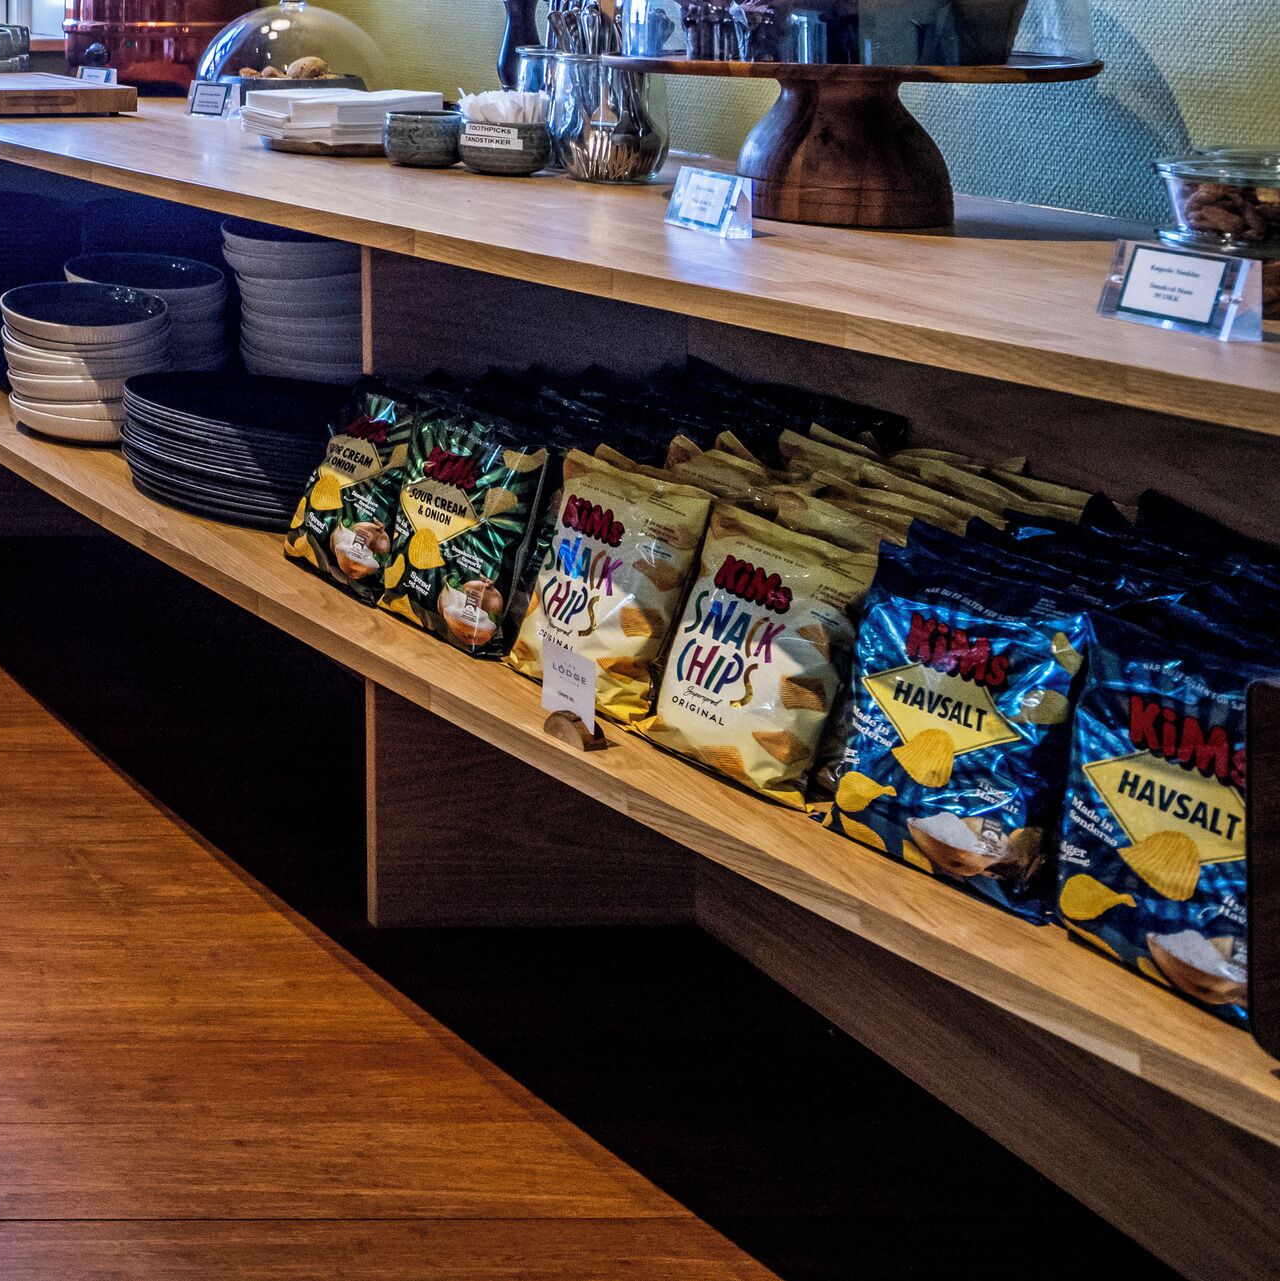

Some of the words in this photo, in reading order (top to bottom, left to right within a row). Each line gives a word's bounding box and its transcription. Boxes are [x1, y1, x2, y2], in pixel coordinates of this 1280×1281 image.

[465, 135, 511, 146] TANDSTIKKER
[468, 124, 512, 135] TOOTHPICKS
[331, 456, 357, 474] ONION
[342, 448, 374, 468] CREAM
[409, 487, 432, 505] SOUR
[434, 496, 467, 518] CREAM
[417, 505, 424, 515] &
[424, 509, 452, 526] ONION
[544, 530, 623, 596] SNACK
[714, 554, 793, 614] KiMs
[542, 575, 600, 637] CHIPS
[684, 590, 786, 663] SNACK
[677, 638, 759, 708] CHIPS
[906, 612, 1010, 687] KiMs
[671, 695, 725, 727] ORIGINAL
[892, 679, 987, 732] HAVSALT
[1129, 695, 1246, 786] KiMs
[1071, 795, 1101, 823] Made
[1100, 819, 1114, 833] in
[1117, 769, 1242, 840] HAVSALT
